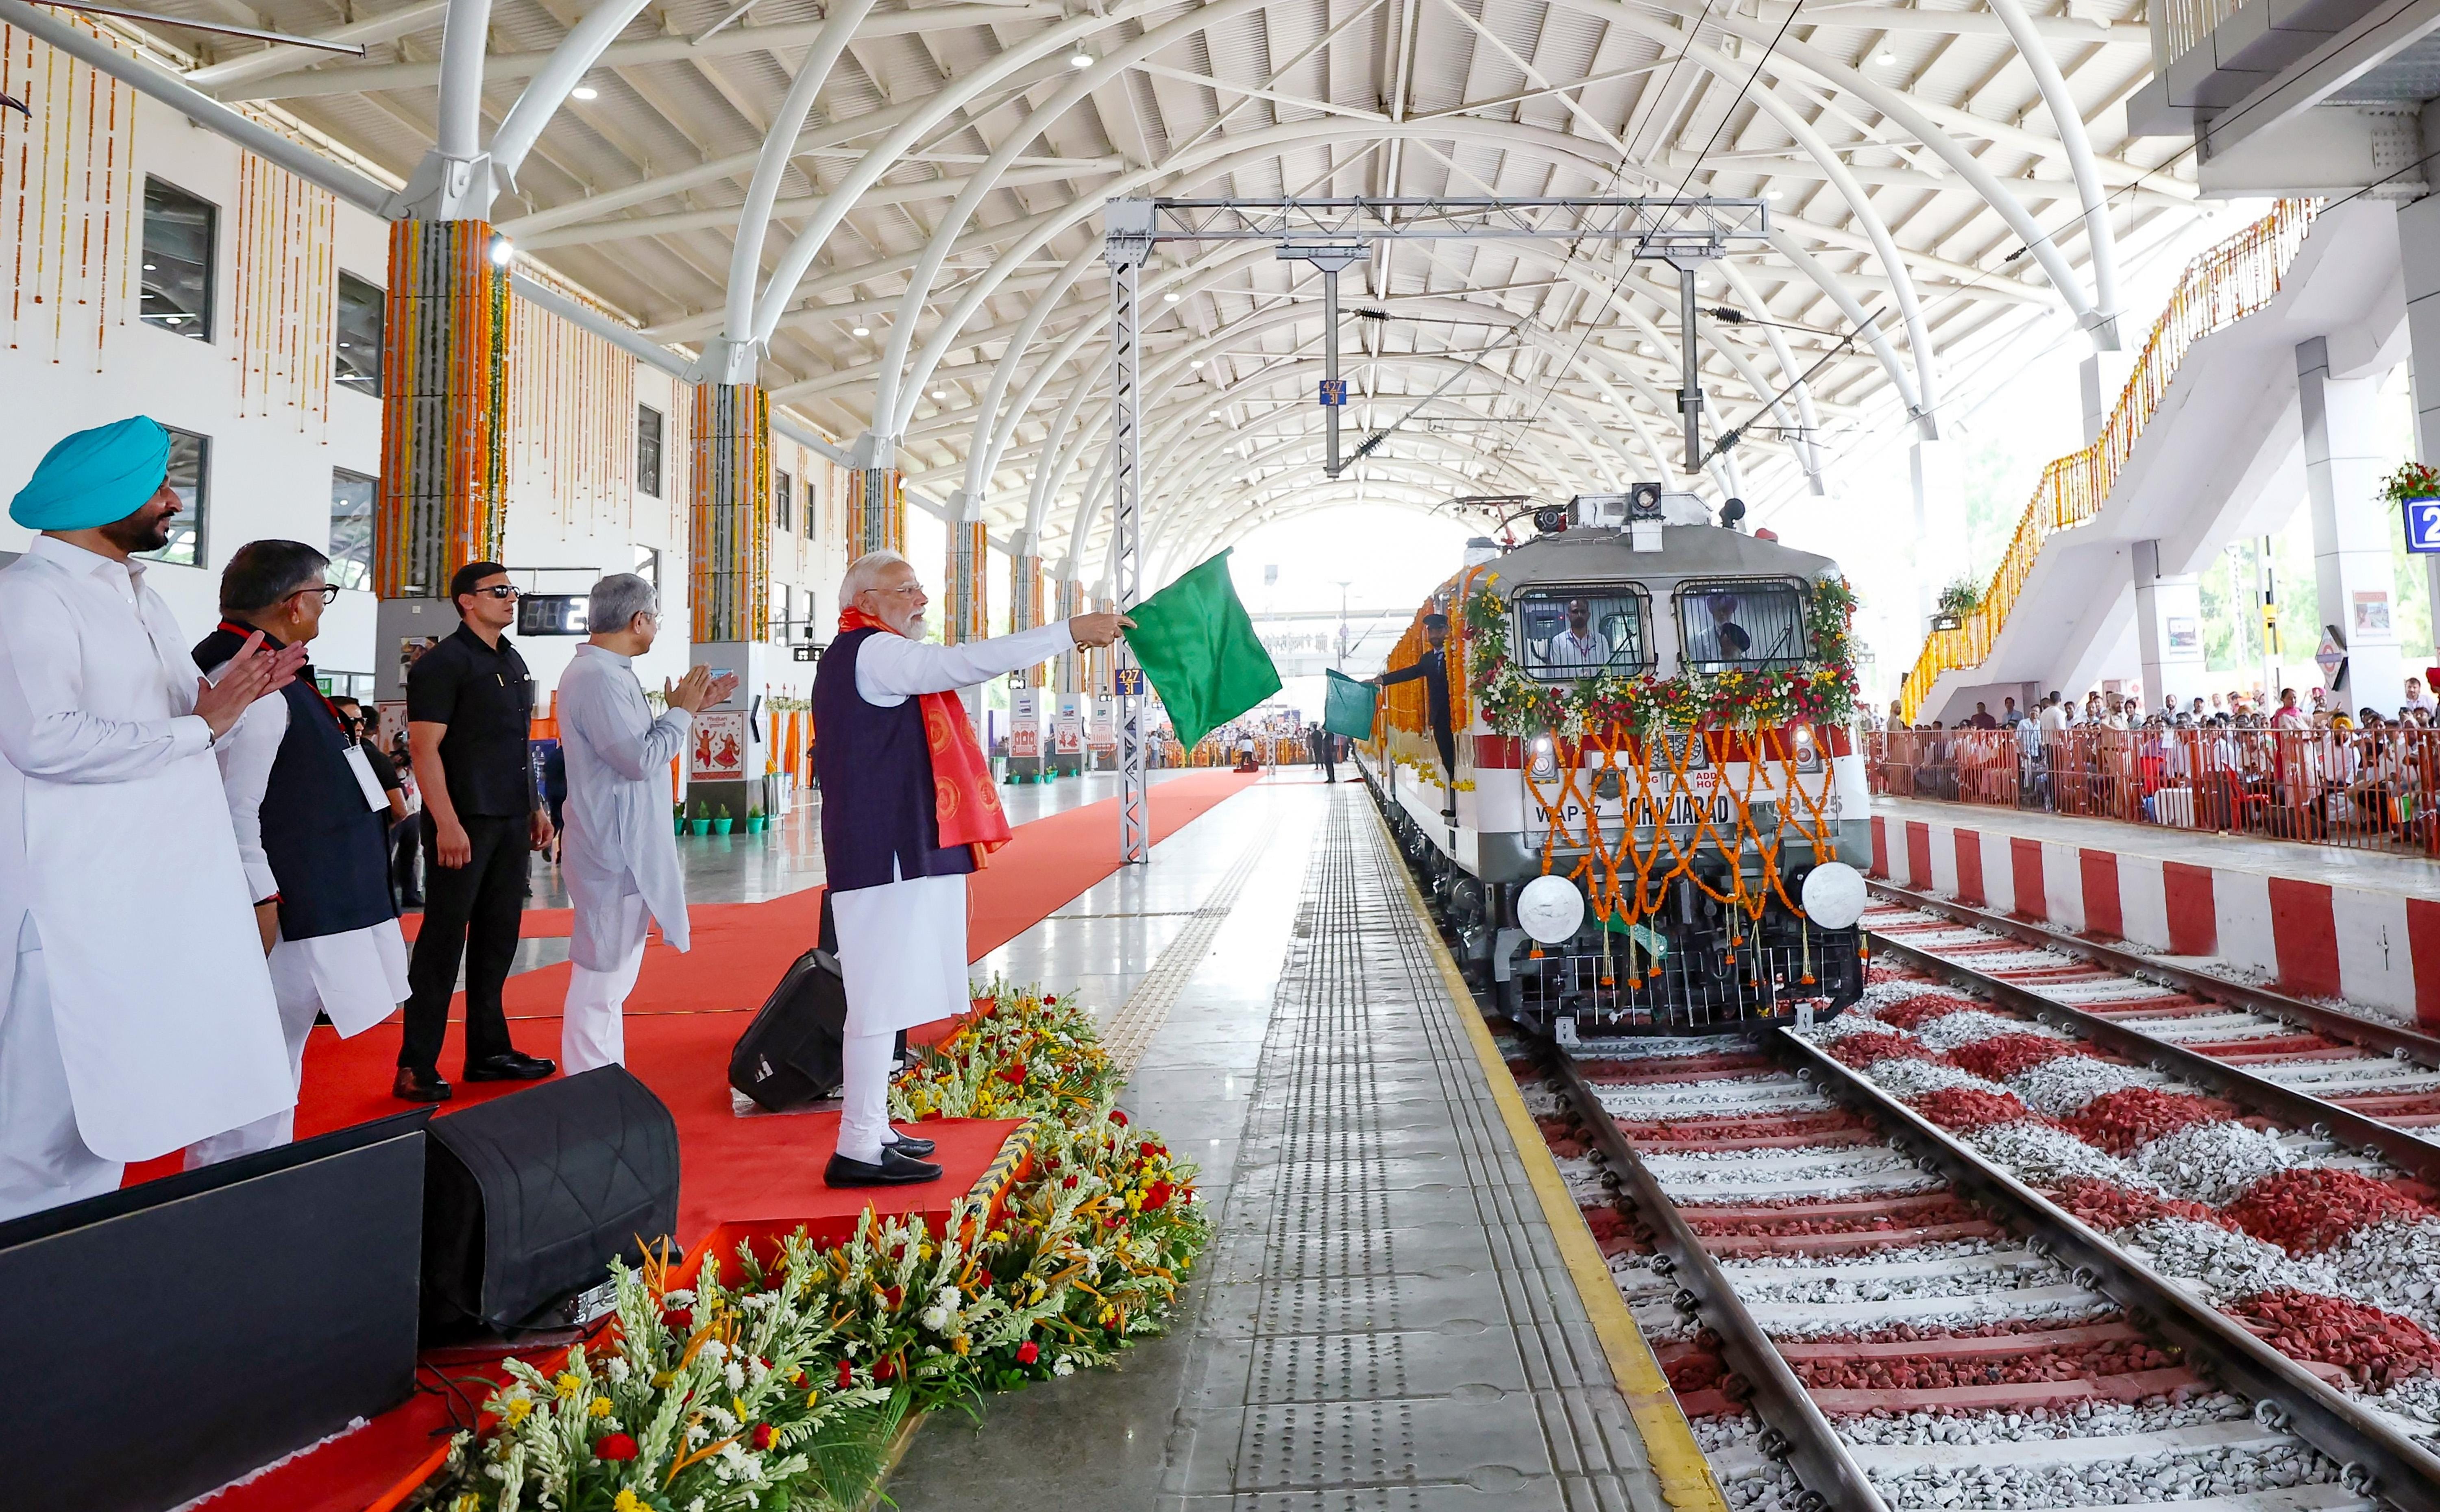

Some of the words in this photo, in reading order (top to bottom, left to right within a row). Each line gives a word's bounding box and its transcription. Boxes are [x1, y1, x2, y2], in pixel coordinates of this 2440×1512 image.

[1323, 381, 1343, 392] 427
[1329, 393, 1338, 404] 31
[2423, 507, 2440, 541] 2
[1119, 670, 1139, 682] 427
[1124, 683, 1134, 694] 31
